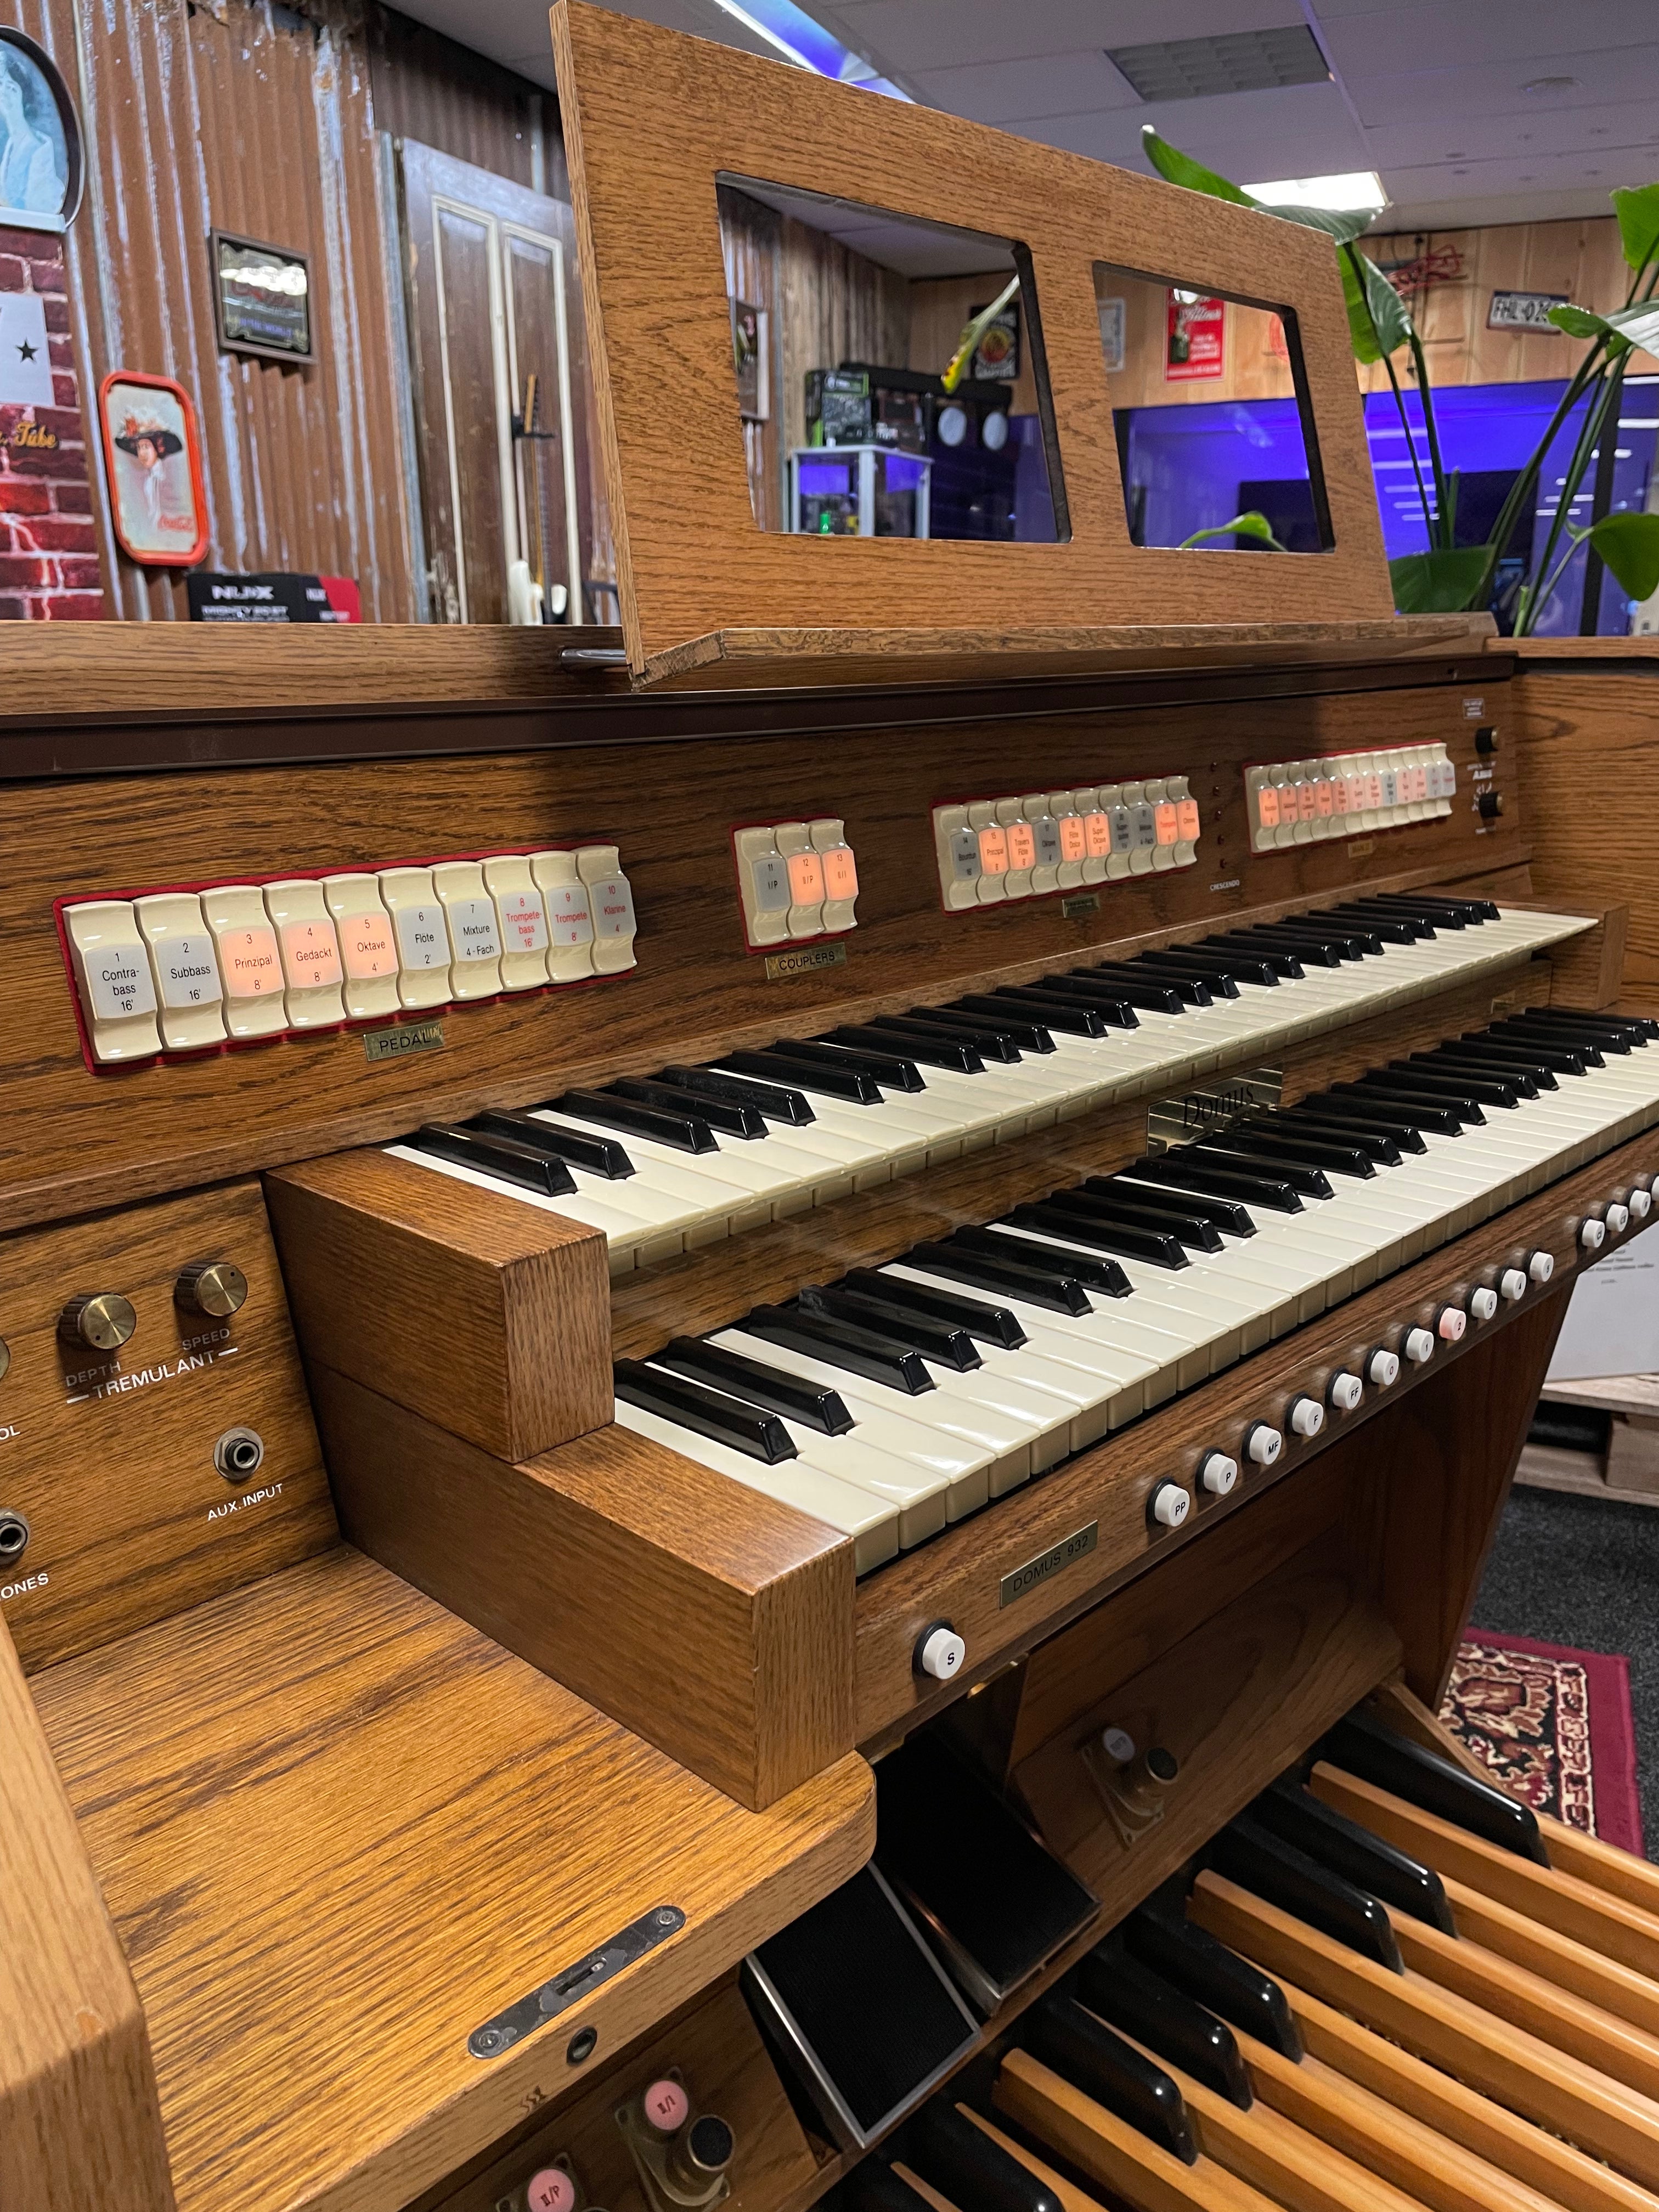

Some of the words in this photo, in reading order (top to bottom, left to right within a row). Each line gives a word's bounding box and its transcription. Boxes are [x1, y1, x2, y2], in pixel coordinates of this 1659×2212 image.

[803, 859, 809, 867] 12
[837, 854, 843, 862] 13
[768, 863, 773, 872] 11
[608, 885, 616, 895] 10
[1210, 879, 1240, 891] CRESCENDO
[520, 898, 525, 907] 8
[565, 893, 571, 902] 9
[470, 904, 475, 913] 7
[419, 912, 424, 922] 6
[555, 911, 588, 924] Trompete
[365, 919, 370, 929] 5
[463, 924, 490, 936] Mixture
[518, 924, 535, 935] bass
[307, 928, 313, 937] 4
[415, 932, 435, 944] Flöte
[246, 934, 252, 944] 3
[183, 943, 189, 953] 2
[357, 940, 386, 952] Oktave
[115, 952, 120, 962] 1
[296, 947, 332, 962] Gedackt
[780, 951, 835, 970] COUPLERS
[235, 955, 273, 969] Prinzipal
[101, 968, 140, 982] Contra-
[170, 964, 211, 979] Subbass
[112, 984, 136, 996] bass
[379, 1034, 431, 1053] PEDAL
[1183, 1083, 1255, 1130] Domus
[1517, 1282, 1522, 1290] 4
[1488, 1301, 1493, 1310] 3
[1457, 1322, 1462, 1331] 2
[182, 1328, 230, 1351] SPEED
[65, 1361, 121, 1387] DEPTH
[94, 1351, 215, 1398] TREMULANT
[1350, 1386, 1359, 1400] FF
[1313, 1414, 1319, 1425] F
[1268, 1440, 1279, 1455] MF
[1225, 1472, 1231, 1483] P
[1175, 1501, 1186, 1516] PP
[1013, 1550, 1062, 1592] DOMUS
[1066, 1534, 1089, 1557] 932
[946, 1652, 955, 1666] S
